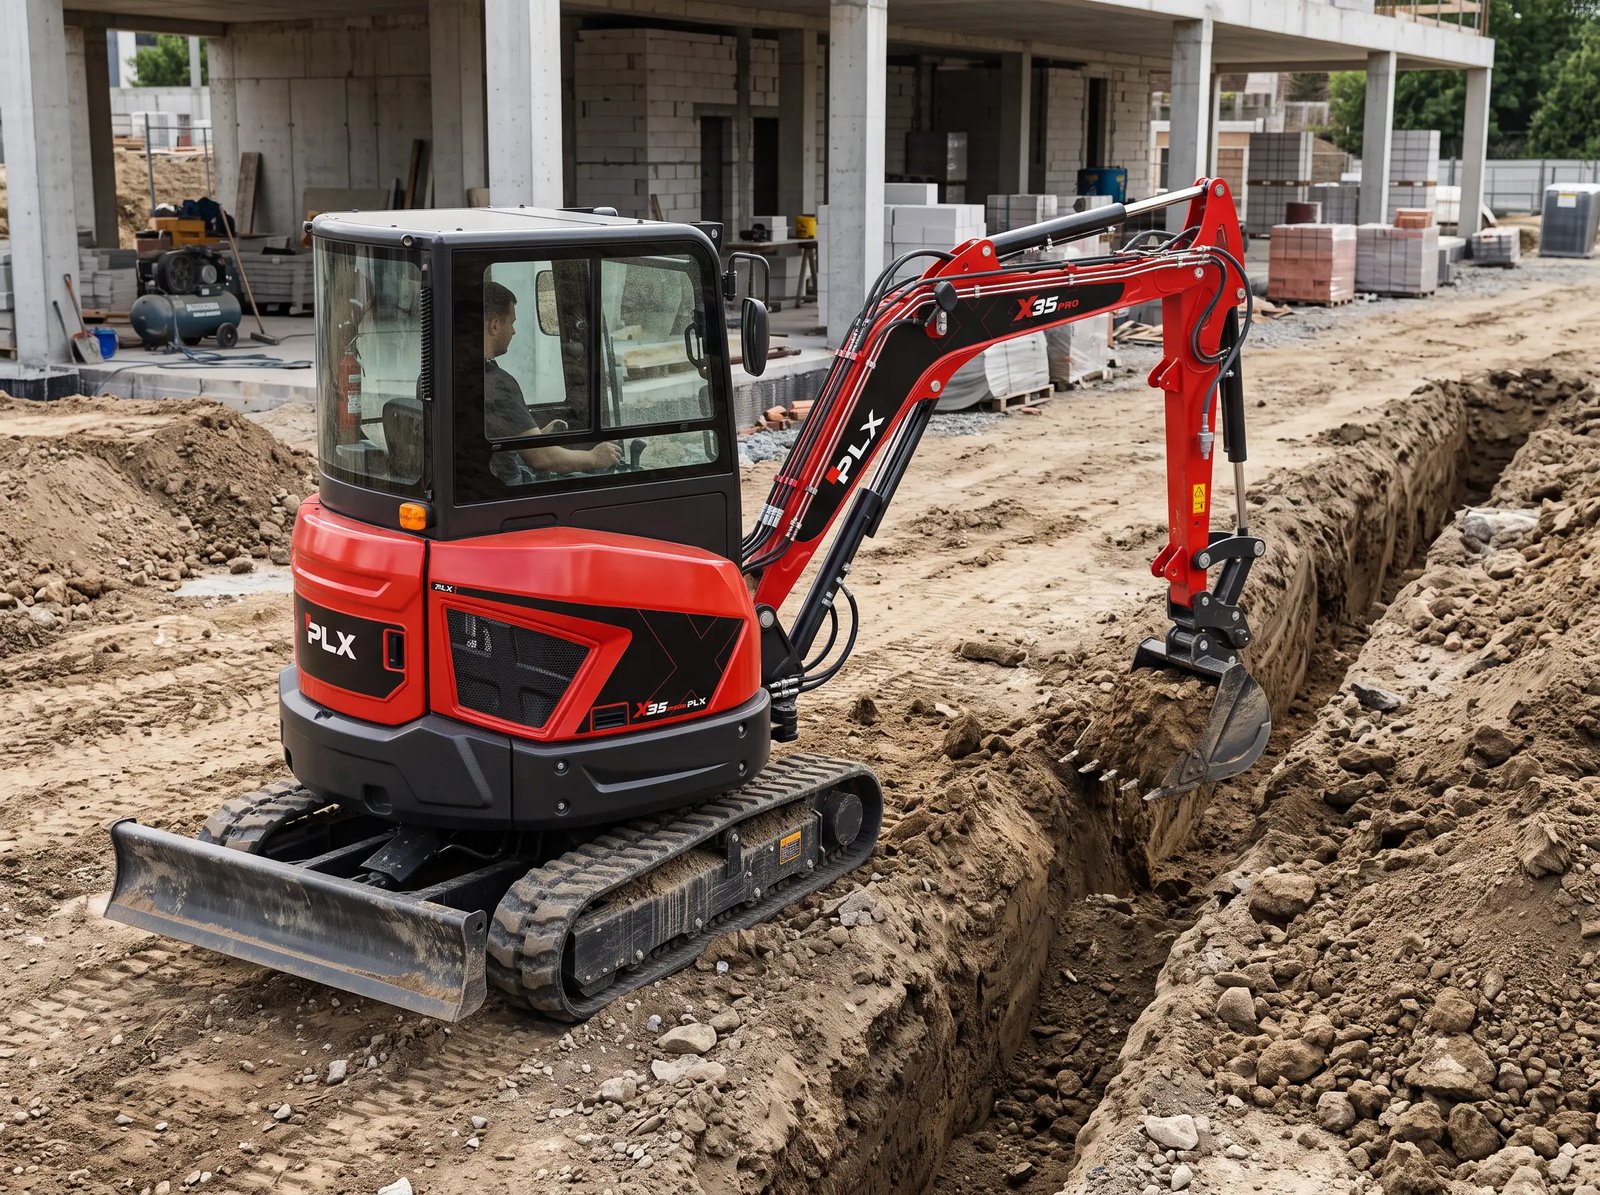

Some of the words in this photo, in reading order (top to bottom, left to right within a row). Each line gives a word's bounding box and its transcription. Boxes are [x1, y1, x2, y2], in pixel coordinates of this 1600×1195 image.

[1014, 295, 1059, 321] X35
[1057, 299, 1079, 311] PRO
[831, 409, 885, 484] PLX
[306, 616, 357, 660] PLX
[633, 700, 669, 719] X35
[687, 697, 707, 708] PLX
